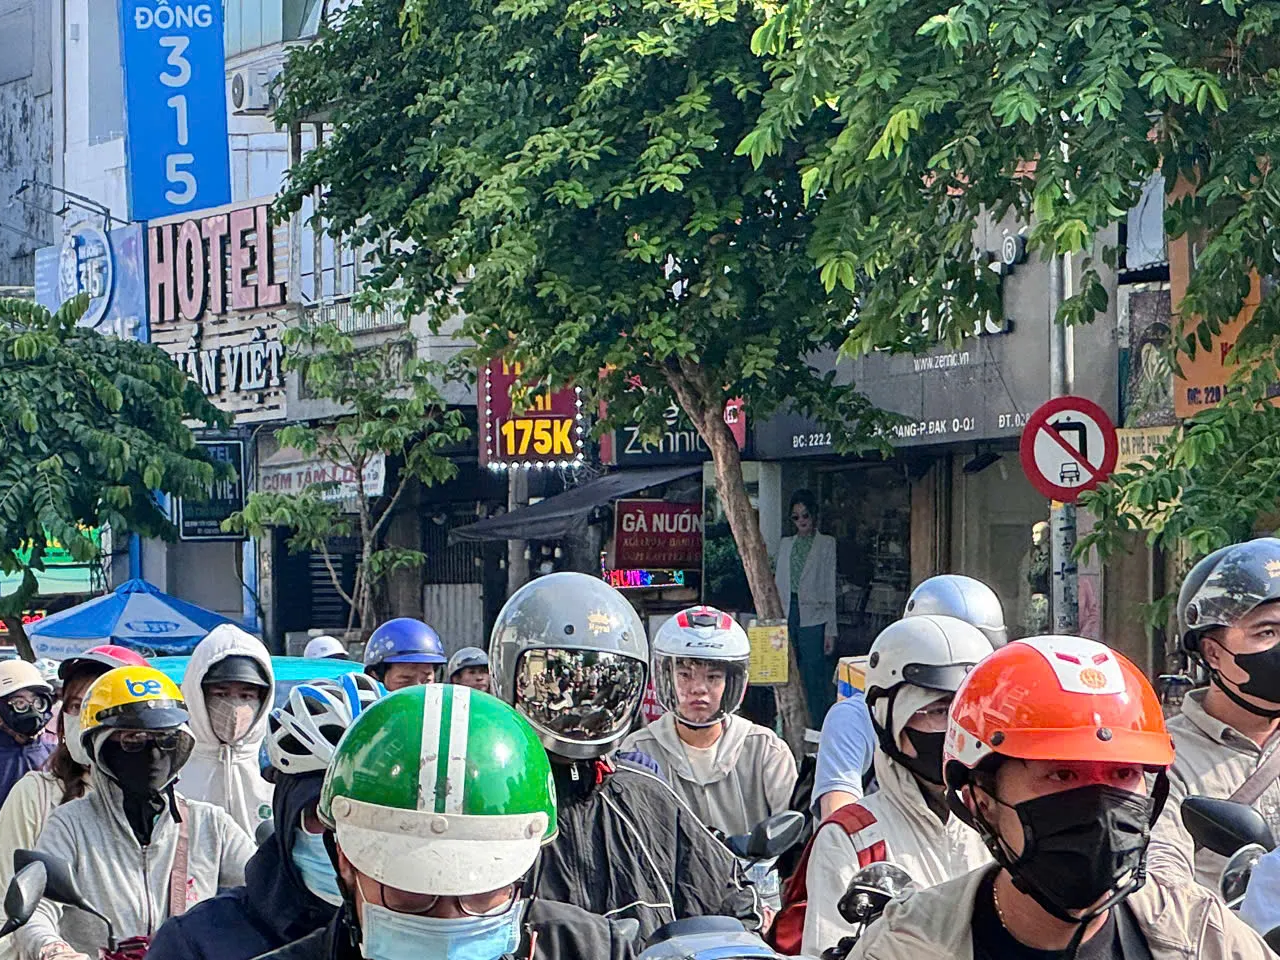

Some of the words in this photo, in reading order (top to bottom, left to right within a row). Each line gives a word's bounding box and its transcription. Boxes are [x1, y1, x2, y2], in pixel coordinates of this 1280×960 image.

[148, 204, 282, 324] HOTEL
[222, 327, 283, 403] VIỆT
[501, 418, 574, 456] 175K
[622, 508, 648, 533] GÀ
[652, 508, 703, 533] NƯỚN
[125, 678, 161, 697] be
